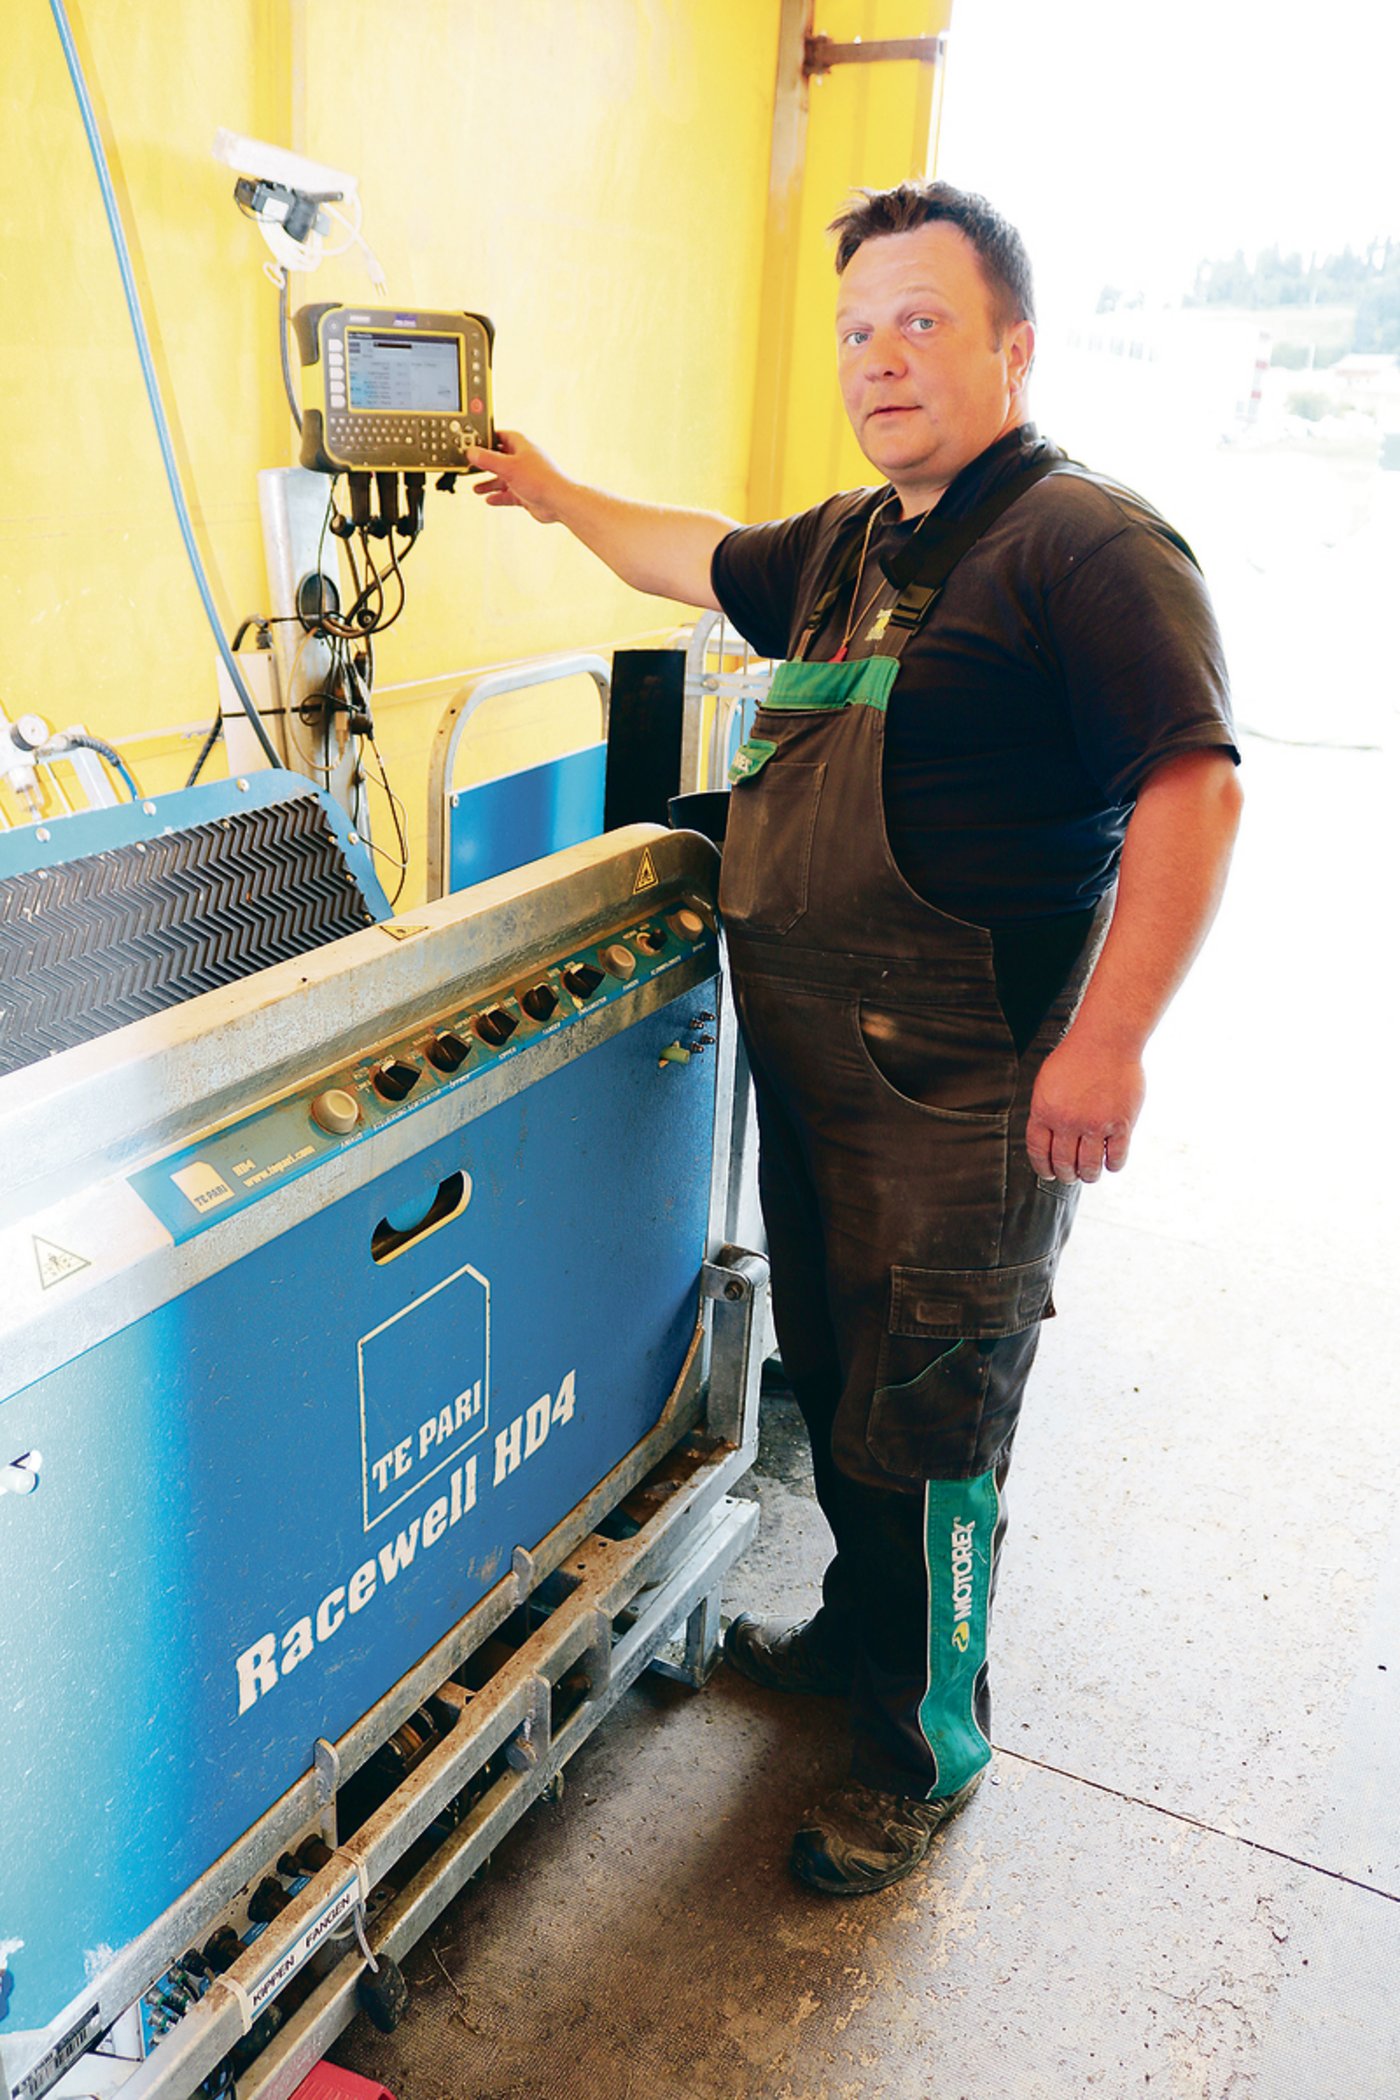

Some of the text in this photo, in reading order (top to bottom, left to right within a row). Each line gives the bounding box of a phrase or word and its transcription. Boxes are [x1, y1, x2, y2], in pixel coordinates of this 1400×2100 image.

[371, 1379, 482, 1494] TE PARI
[235, 1368, 577, 1717] Racewell HD4
[951, 1519, 976, 1622] MOTOREX
[252, 1954, 295, 2007] KIPPEN
[305, 1893, 351, 1948] FANGEN
